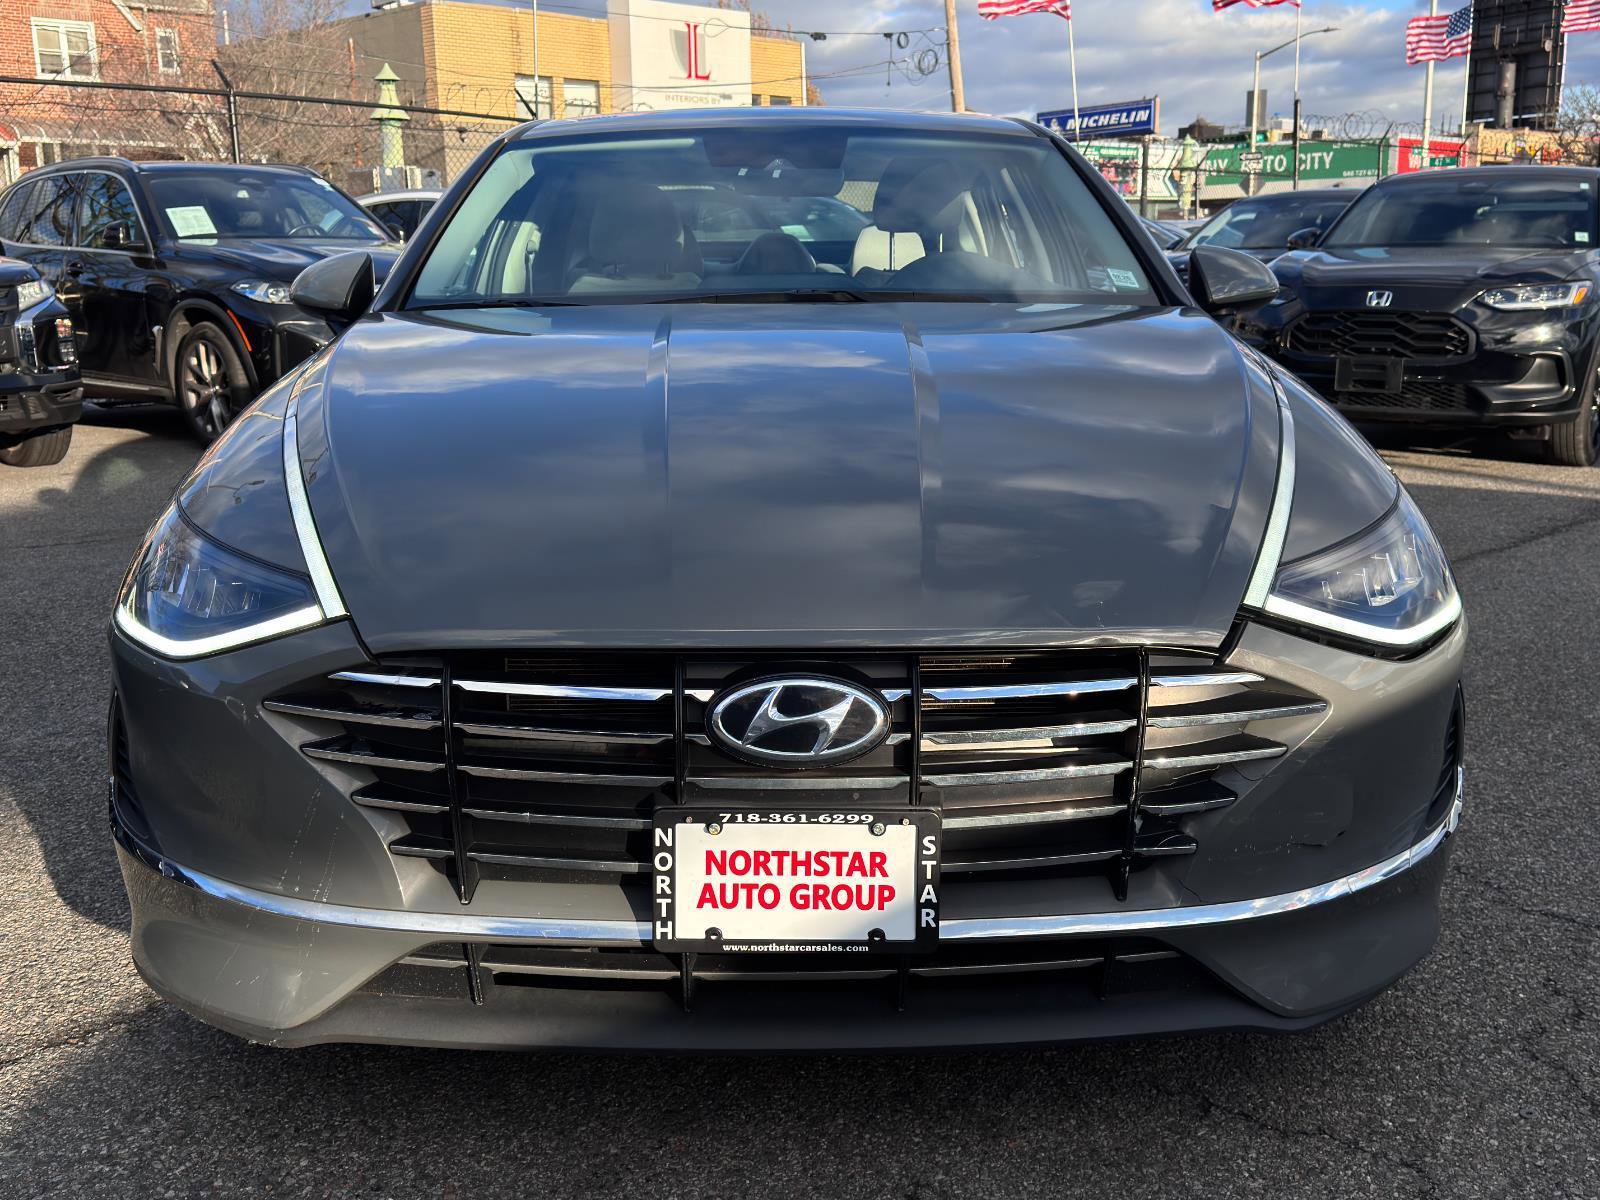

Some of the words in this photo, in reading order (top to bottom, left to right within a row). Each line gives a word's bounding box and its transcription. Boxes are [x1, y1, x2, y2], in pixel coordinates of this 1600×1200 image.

[665, 95, 709, 104] INTERIORS
[1066, 109, 1150, 130] MICHELIN
[1297, 151, 1334, 172] CITY
[719, 813, 874, 824] 718-361-6299
[705, 849, 889, 878] NORTHSTAR
[654, 828, 673, 940] NORTH
[919, 836, 938, 928] STAR
[696, 883, 781, 910] AUTO
[789, 883, 896, 911] GROUP
[722, 942, 869, 953] www.northstarcarsales.com
